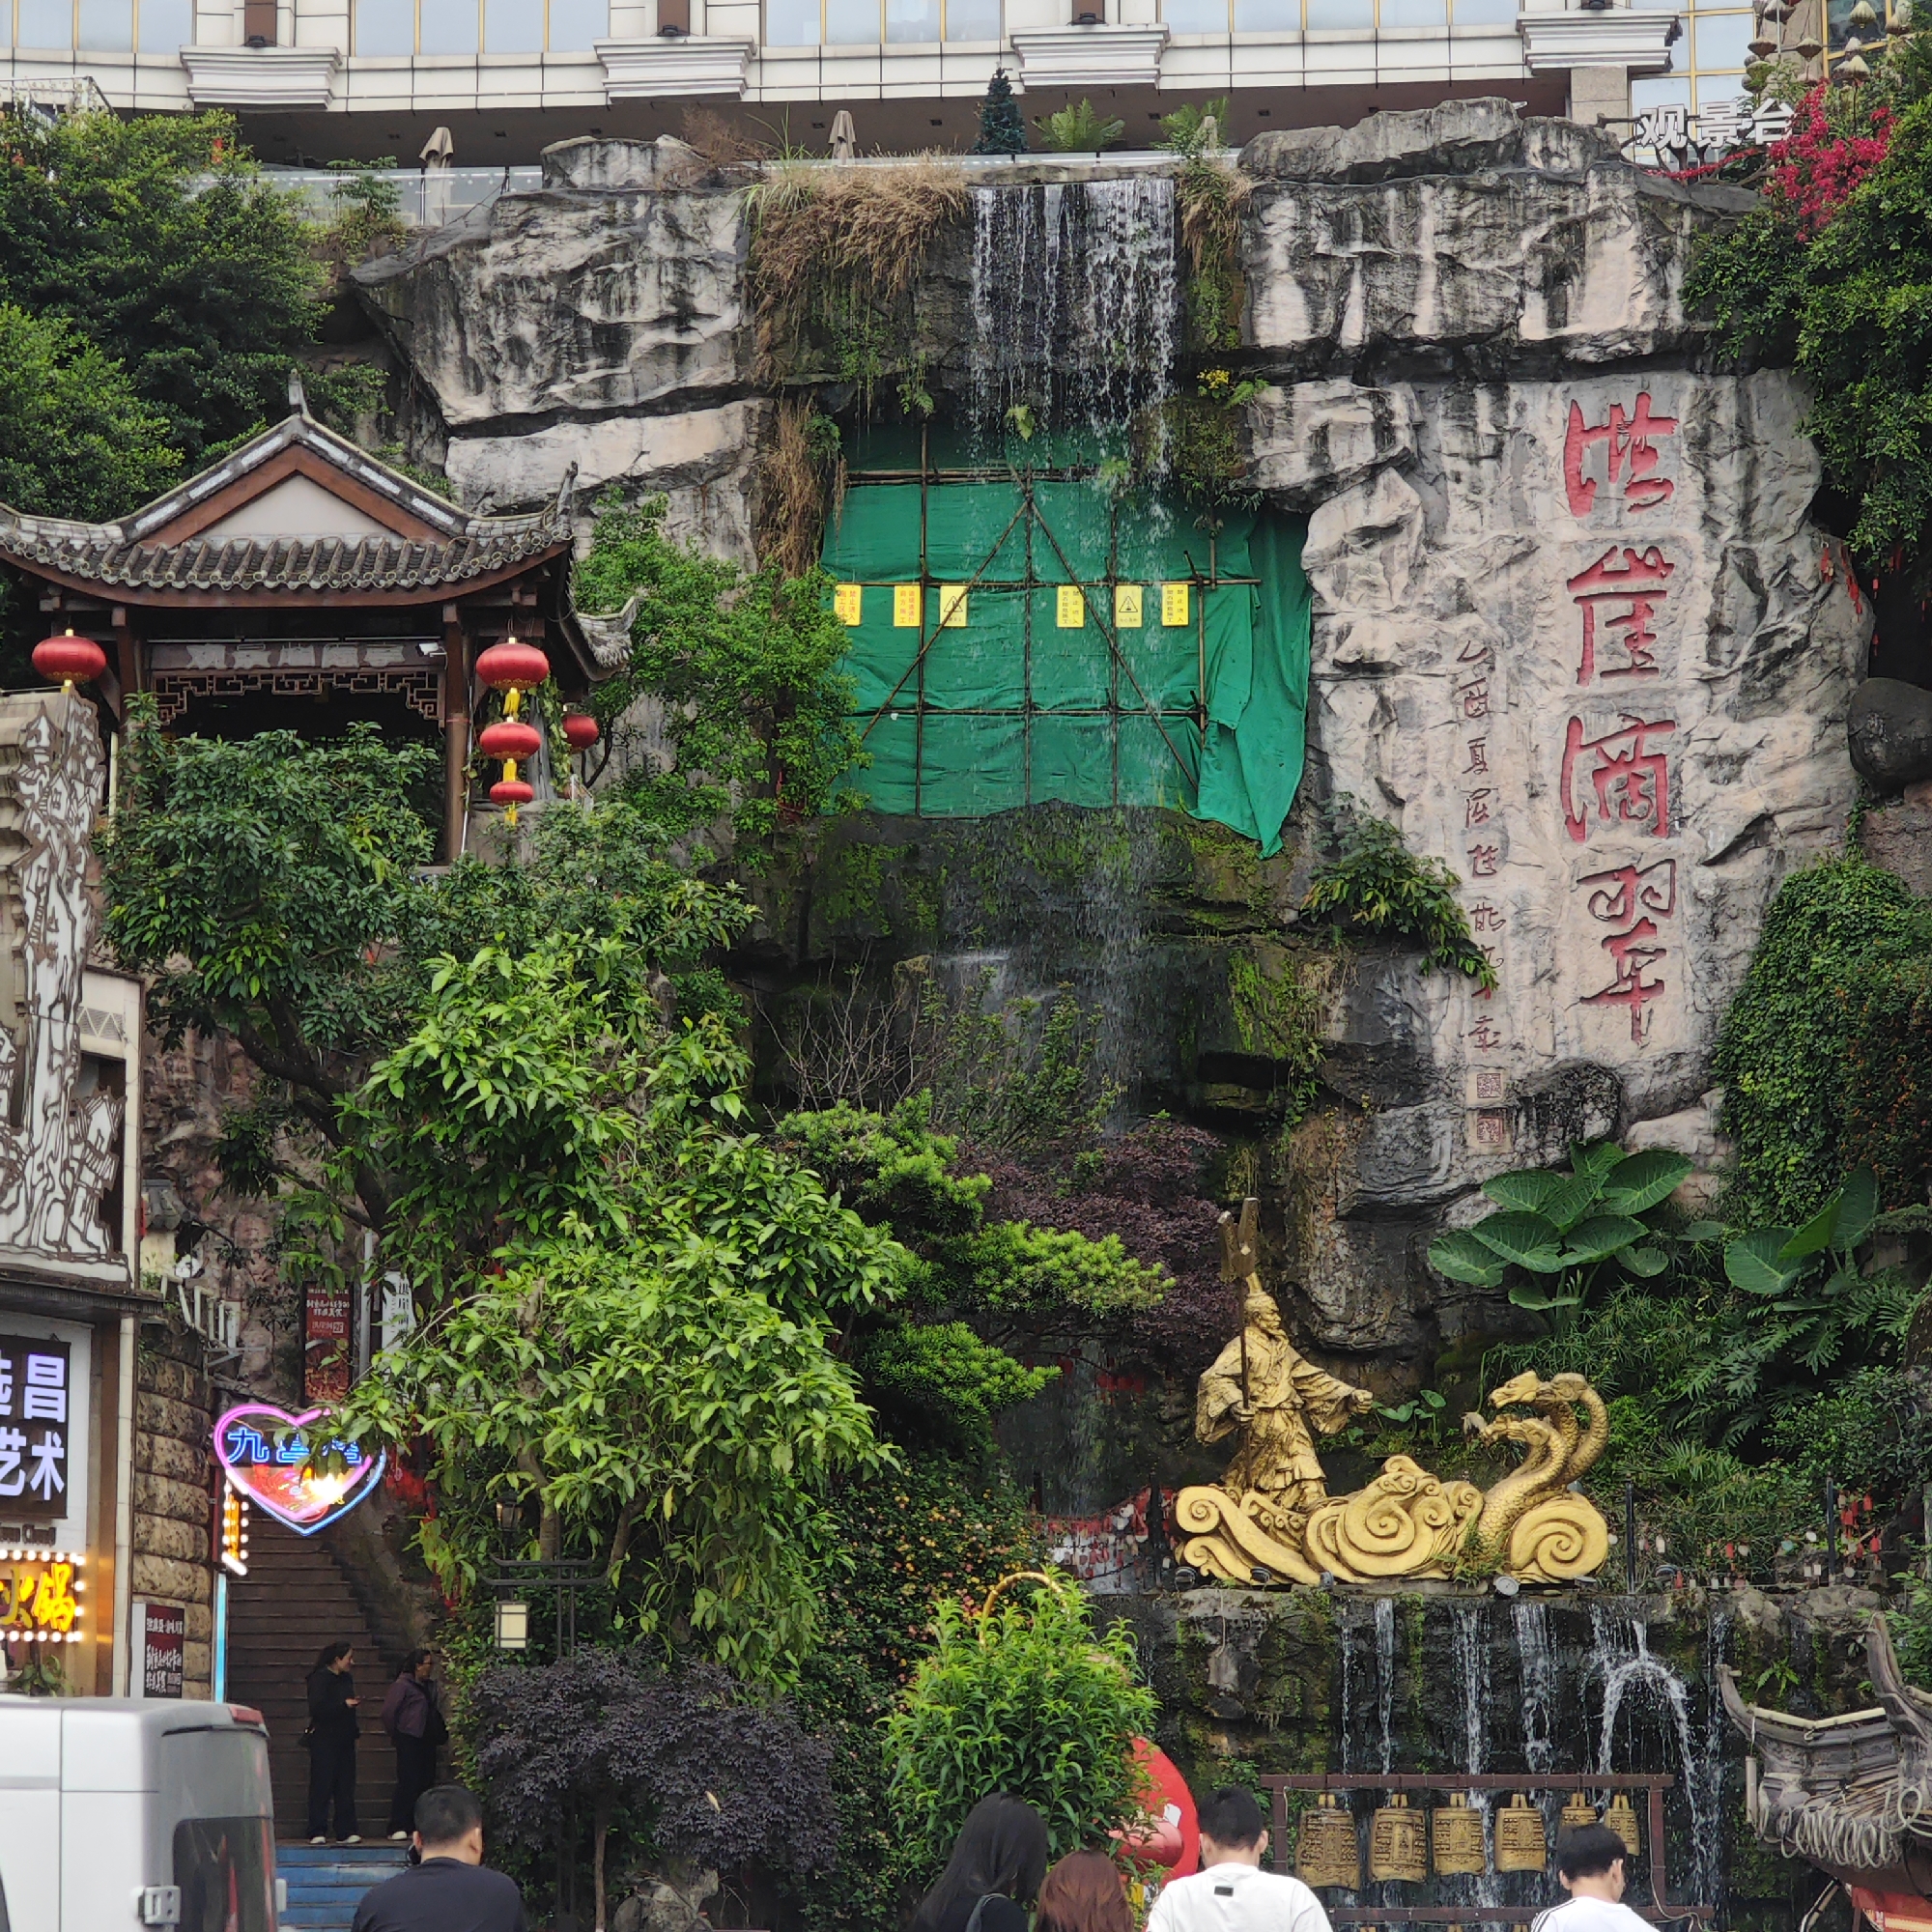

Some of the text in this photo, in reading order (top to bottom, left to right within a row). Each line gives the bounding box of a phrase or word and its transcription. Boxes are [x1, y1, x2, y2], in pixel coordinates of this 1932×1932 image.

[1640, 98, 1793, 150] 观景台
[333, 1322, 343, 1332] 2F
[0, 1426, 65, 1501] 艺术
[0, 1562, 76, 1633] 火锅
